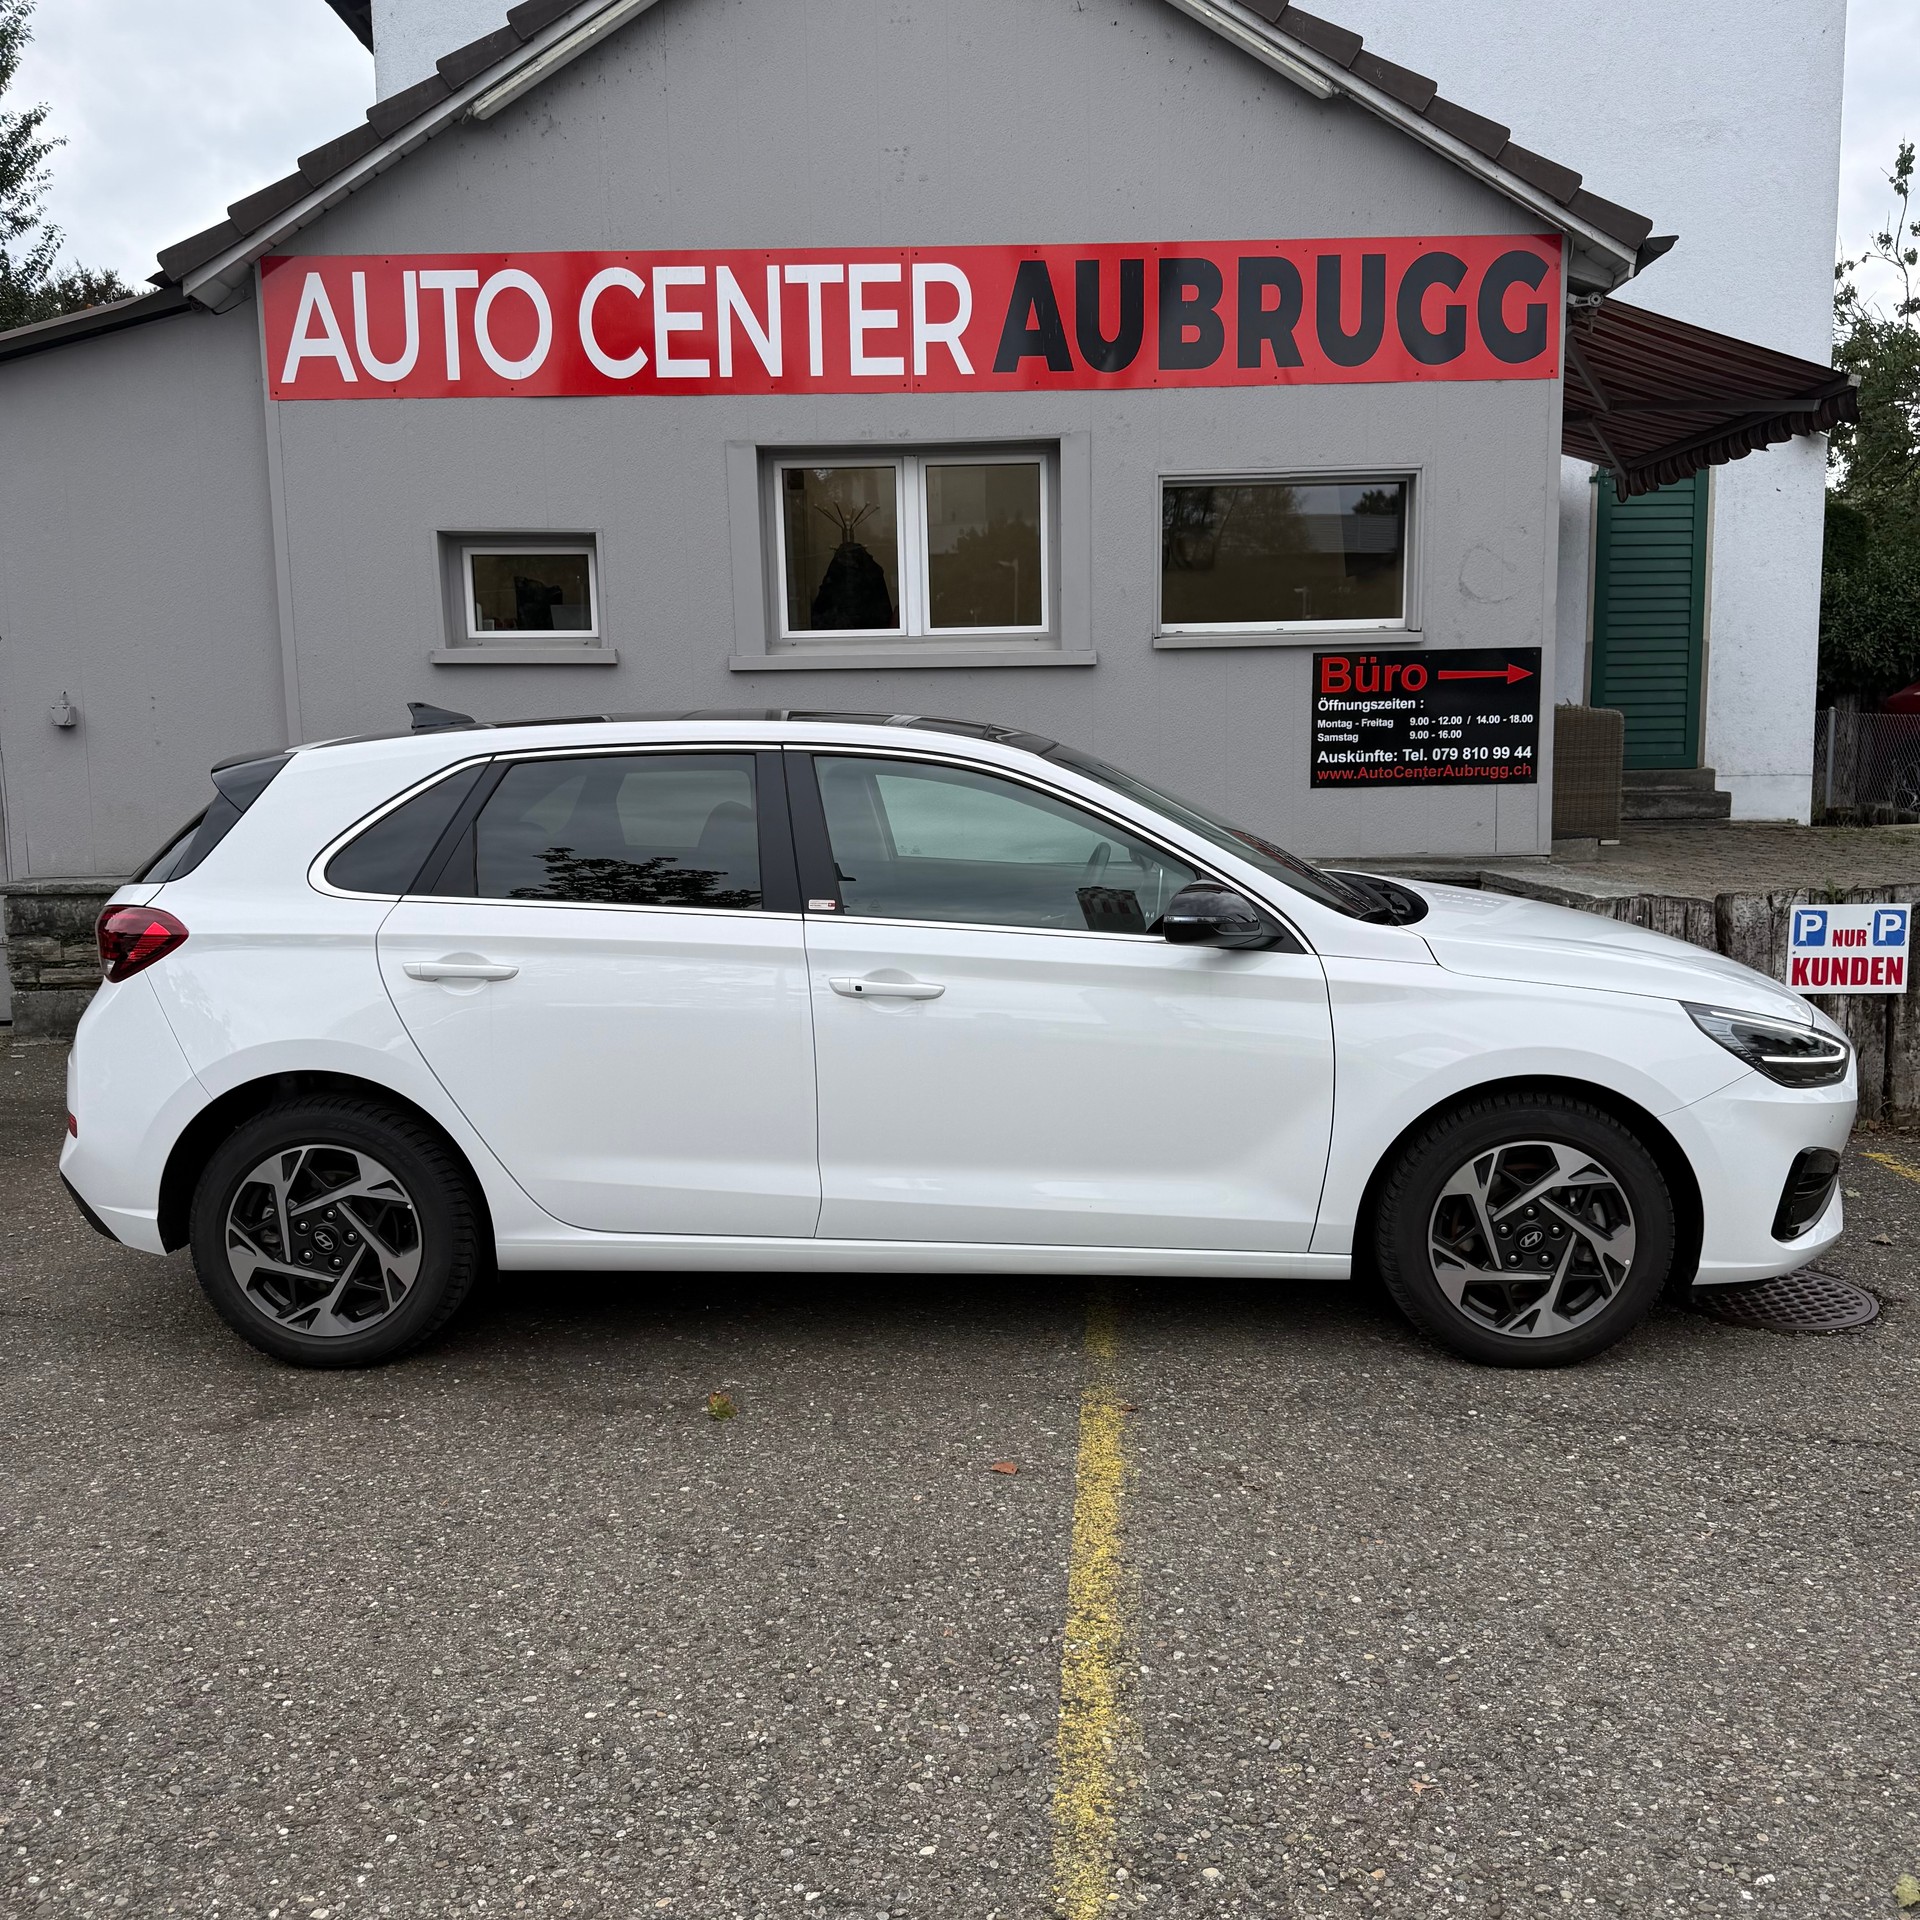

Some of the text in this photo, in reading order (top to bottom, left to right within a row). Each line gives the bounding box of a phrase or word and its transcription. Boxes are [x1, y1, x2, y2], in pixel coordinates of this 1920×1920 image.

[282, 250, 1548, 383] AUTO CENTER AUBRUGG
[1321, 657, 1427, 693] Büro
[1318, 698, 1415, 712] Öffnungszeiten
[1318, 720, 1352, 729] Montag
[1362, 718, 1393, 728] Freitag
[1410, 717, 1429, 725] 9.00
[1438, 716, 1462, 724] 12.00
[1476, 715, 1500, 724] 14.00
[1509, 714, 1533, 723] 18.00
[1318, 733, 1358, 743] Samstag
[1410, 731, 1429, 739] 9.00
[1438, 730, 1462, 738] 16.00
[1317, 746, 1532, 763] Auskünfte: Tel. 079 810 99 44
[1318, 763, 1531, 780] www.AutoCenterAubrugg.ch
[1832, 929, 1867, 947] NUR
[1792, 957, 1903, 986] KUNDEN
